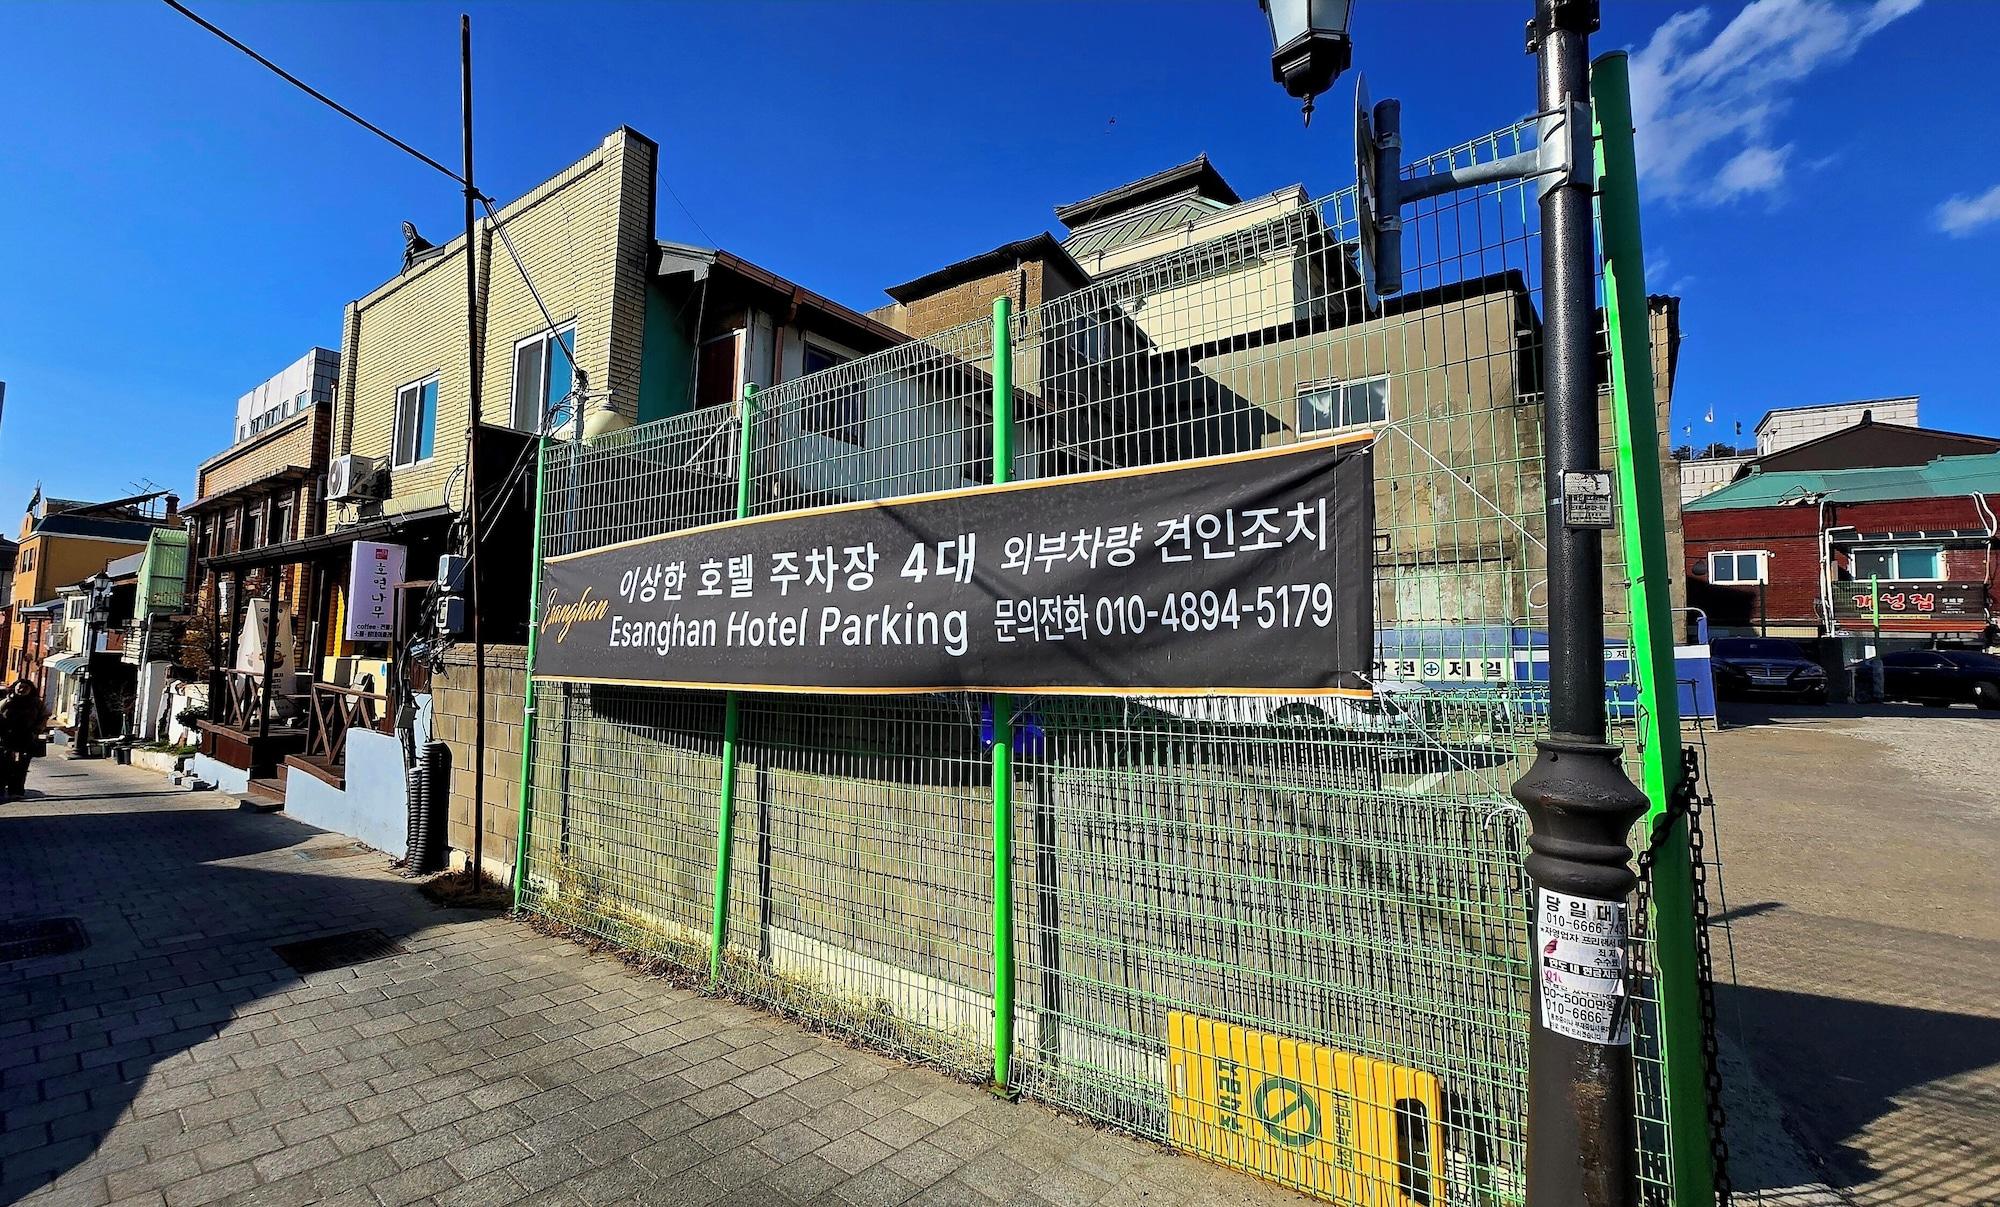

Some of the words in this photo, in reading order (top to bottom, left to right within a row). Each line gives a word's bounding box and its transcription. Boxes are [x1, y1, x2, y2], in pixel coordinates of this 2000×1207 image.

[619, 561, 687, 604] 이상한
[697, 553, 754, 598] 호텔
[770, 541, 880, 596] 주차장
[900, 532, 977, 585] 4대
[1000, 522, 1143, 575] 외부차량
[1153, 497, 1327, 564] 견인조치
[609, 613, 717, 657] Esanghan
[726, 608, 807, 647] Hotel
[818, 601, 968, 657] Parking
[993, 593, 1088, 643] 문의전화
[1095, 582, 1333, 637] 010-4894-5179
